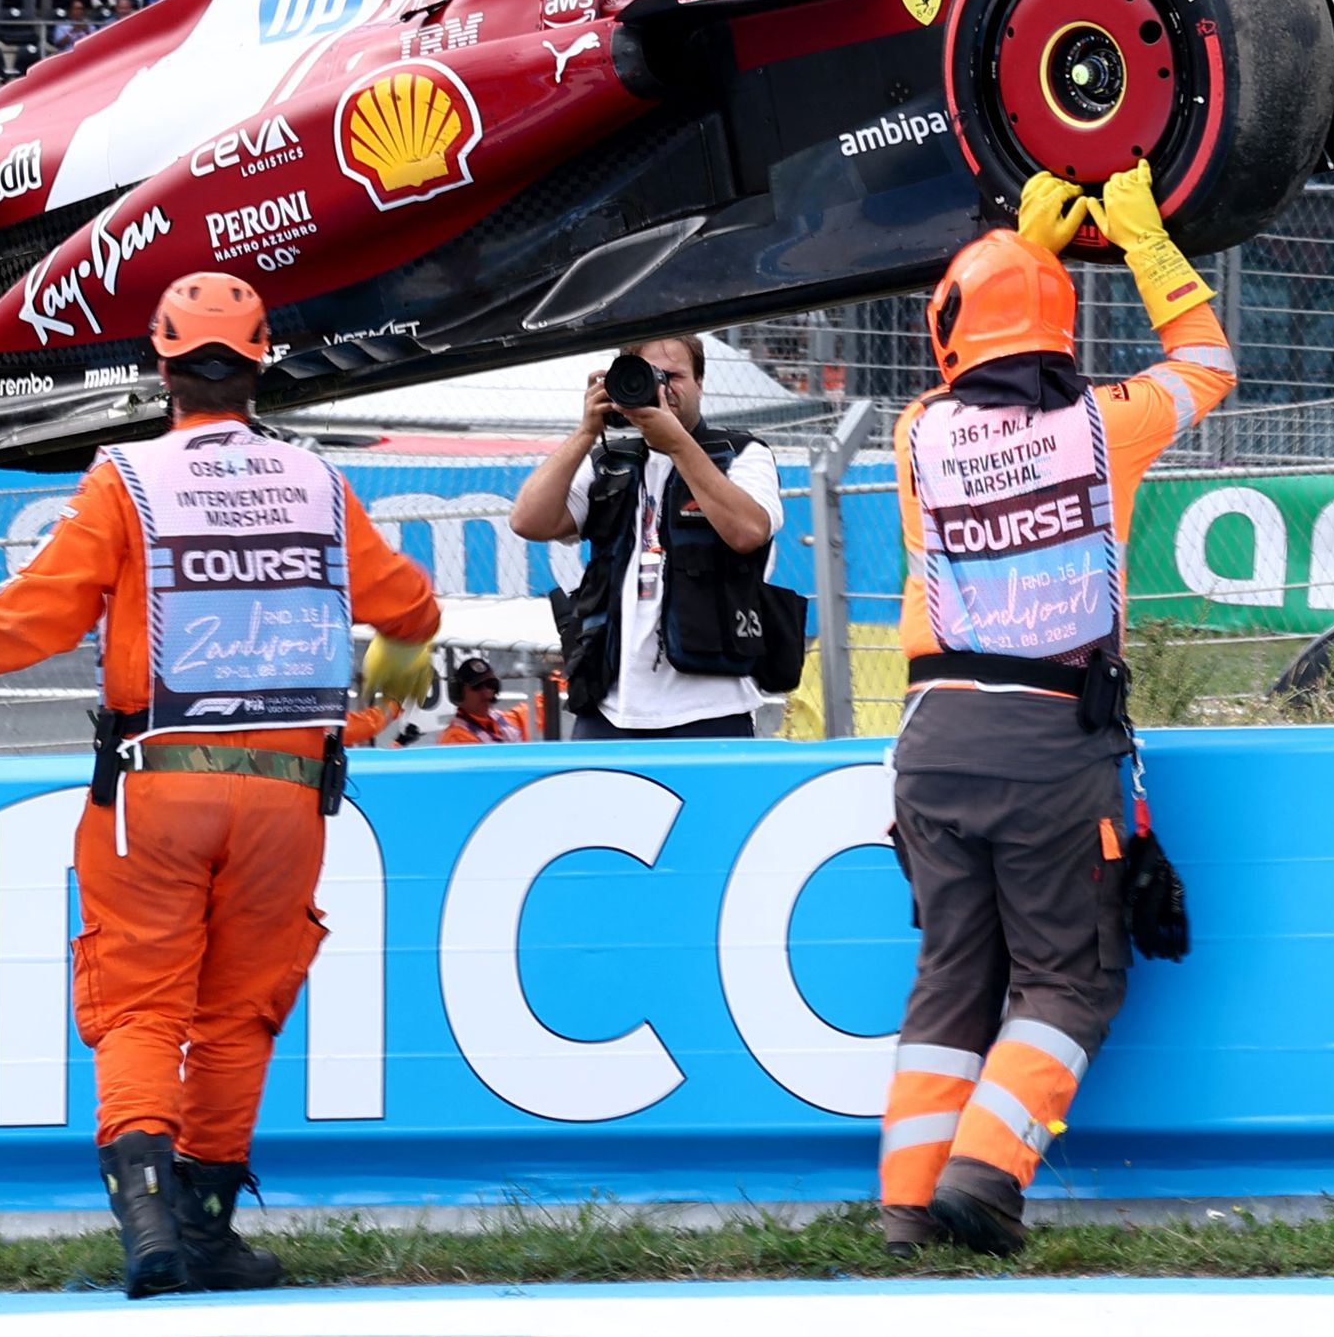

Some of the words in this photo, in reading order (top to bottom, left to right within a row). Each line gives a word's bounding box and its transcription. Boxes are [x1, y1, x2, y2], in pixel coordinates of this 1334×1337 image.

[399, 11, 484, 60] IBM
[838, 109, 951, 157] ambipa
[240, 146, 304, 178] LOGISTICS
[205, 189, 313, 249] PERONI
[214, 240, 260, 263] NASTRO
[262, 222, 318, 248] AZZURRO
[256, 245, 301, 272] 0.0%
[84, 364, 139, 389] MAHLE
[941, 435, 1058, 478] INERVENTION
[176, 486, 309, 509] INTERVENTION
[963, 462, 1042, 499] MARSHAL
[205, 508, 294, 529] MARSHAL
[944, 493, 1084, 554] COURSE
[181, 546, 323, 583] COURSE
[951, 550, 1104, 635] Zandvoort
[170, 600, 344, 675] Zandvoort
